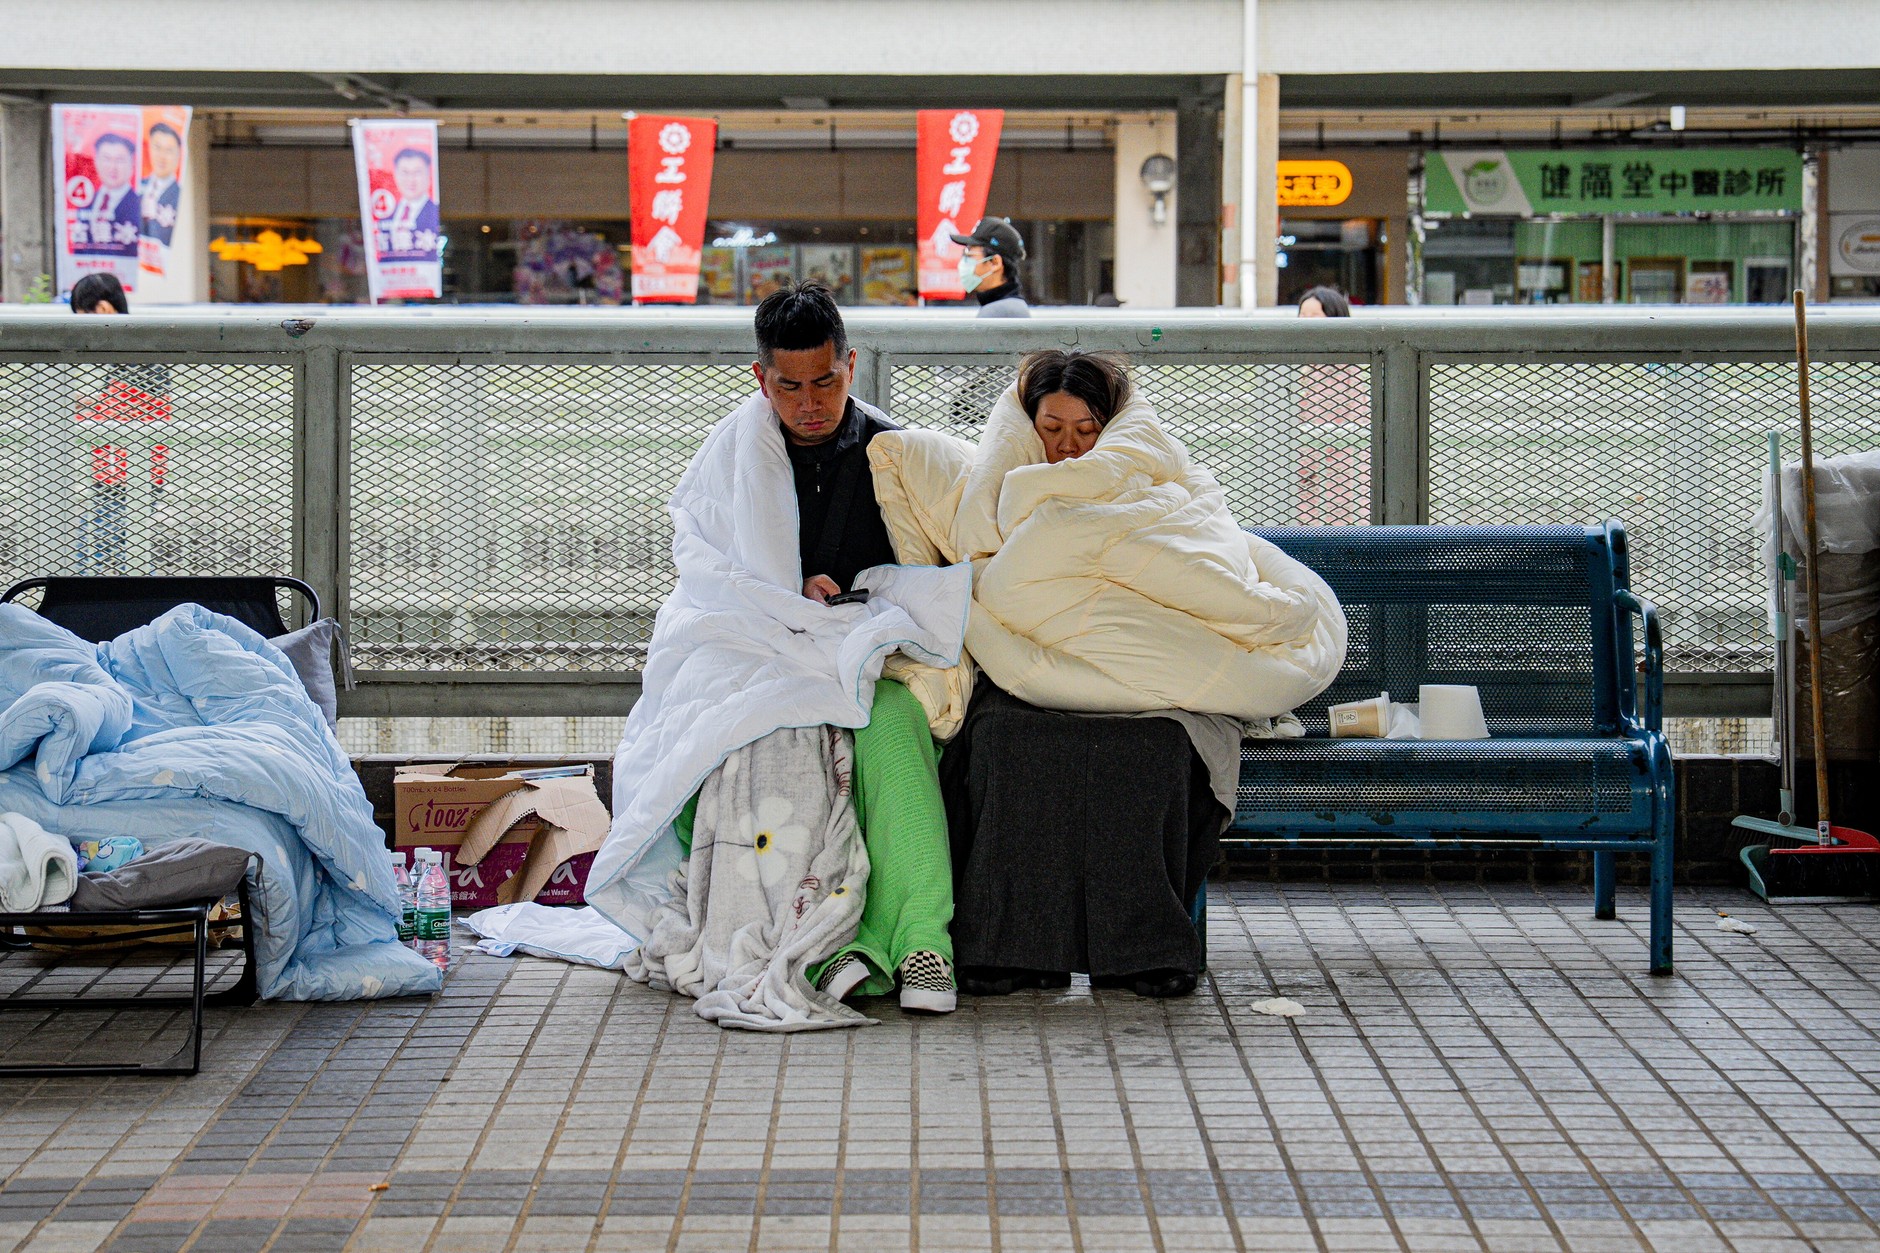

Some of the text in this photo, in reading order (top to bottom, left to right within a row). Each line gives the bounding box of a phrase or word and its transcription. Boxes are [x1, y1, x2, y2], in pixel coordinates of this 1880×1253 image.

[443, 785, 467, 793] Bottles
[424, 807, 468, 829] 100%
[551, 888, 570, 896] Water
